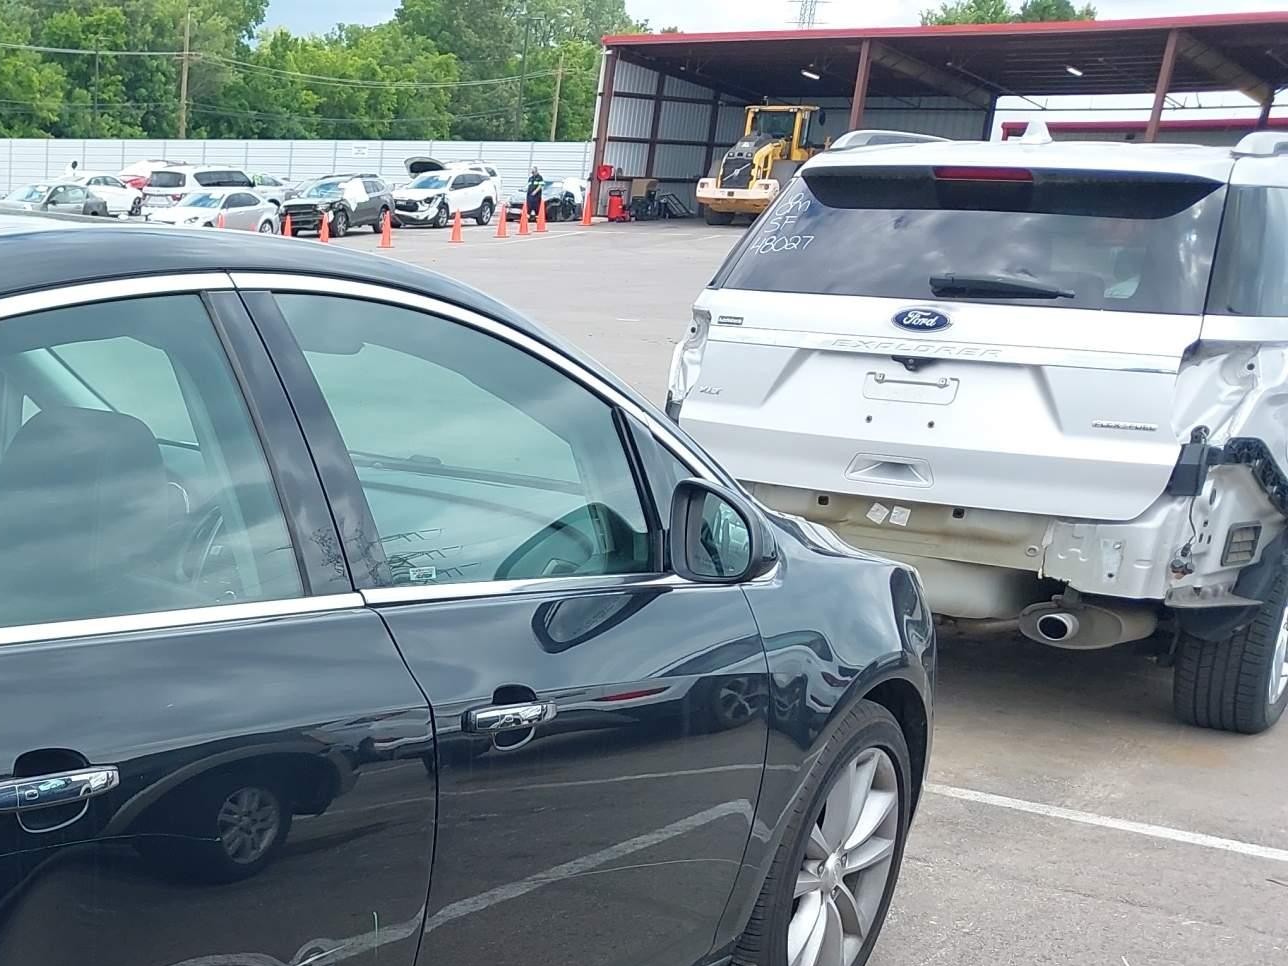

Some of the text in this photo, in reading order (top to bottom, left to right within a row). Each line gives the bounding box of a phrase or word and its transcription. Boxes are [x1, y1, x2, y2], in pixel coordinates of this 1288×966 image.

[764, 215, 798, 233] SF
[750, 235, 815, 255] 48027
[902, 310, 938, 329] Ford
[831, 338, 1003, 359] EXPLORER
